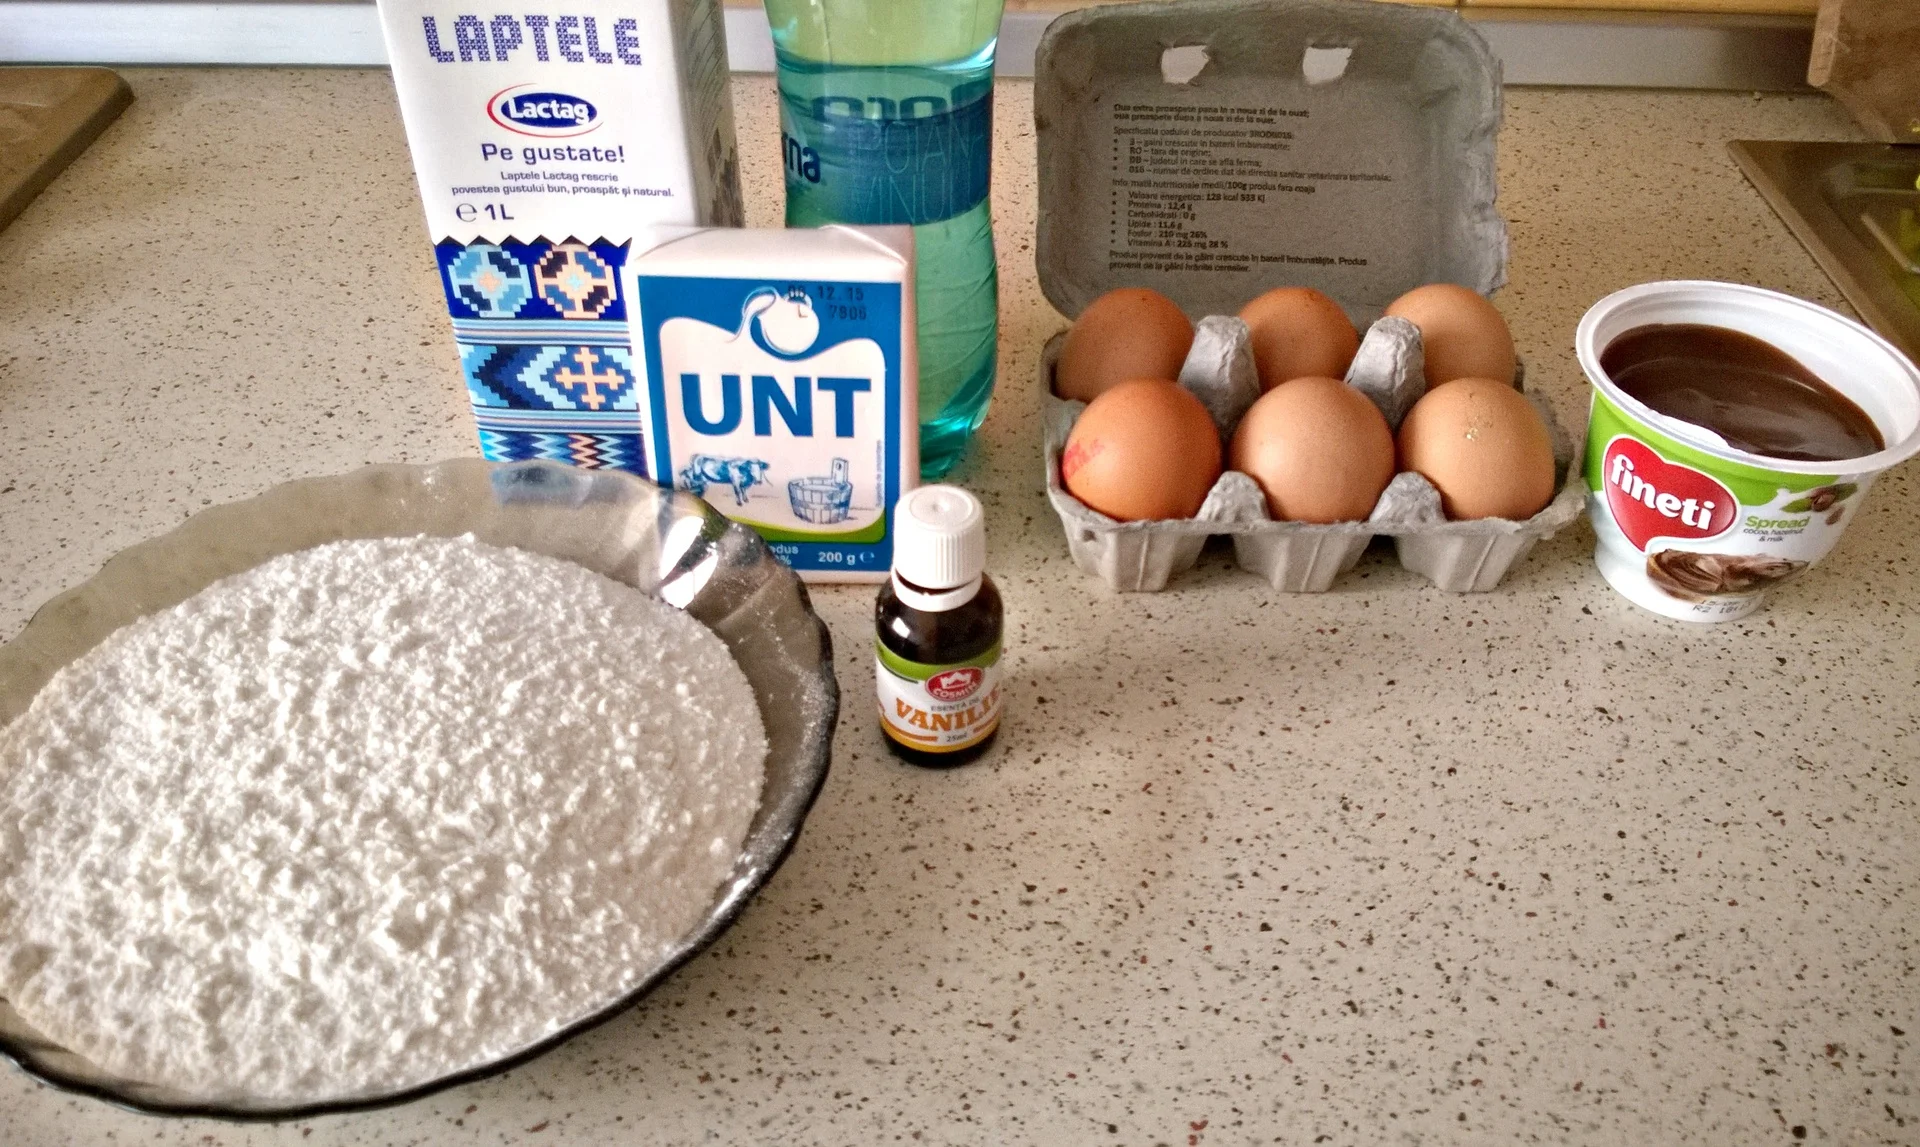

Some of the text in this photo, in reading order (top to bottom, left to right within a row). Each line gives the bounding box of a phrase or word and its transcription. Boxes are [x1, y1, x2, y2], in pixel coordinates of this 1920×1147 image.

[422, 15, 642, 66] LAPTELE
[507, 96, 590, 125] Lactag
[1113, 103, 1131, 112] Oua
[1133, 104, 1153, 113] extra
[481, 142, 625, 165] Pe gustate!
[1130, 147, 1142, 155] RO
[501, 171, 619, 183] Laptele Lactag rescrie
[1181, 167, 1191, 175] de
[1236, 168, 1246, 176] de
[451, 184, 500, 195] povestea
[503, 183, 546, 195] gustului
[547, 184, 570, 195] bun,
[633, 187, 675, 197] natural.
[680, 374, 872, 438] UNT
[1610, 454, 1716, 531] fineti
[1744, 515, 1810, 530] Spread
[1770, 528, 1805, 537] hazelnut
[818, 552, 842, 563] 200
[846, 554, 856, 566] g
[932, 680, 978, 699] COSMIN
